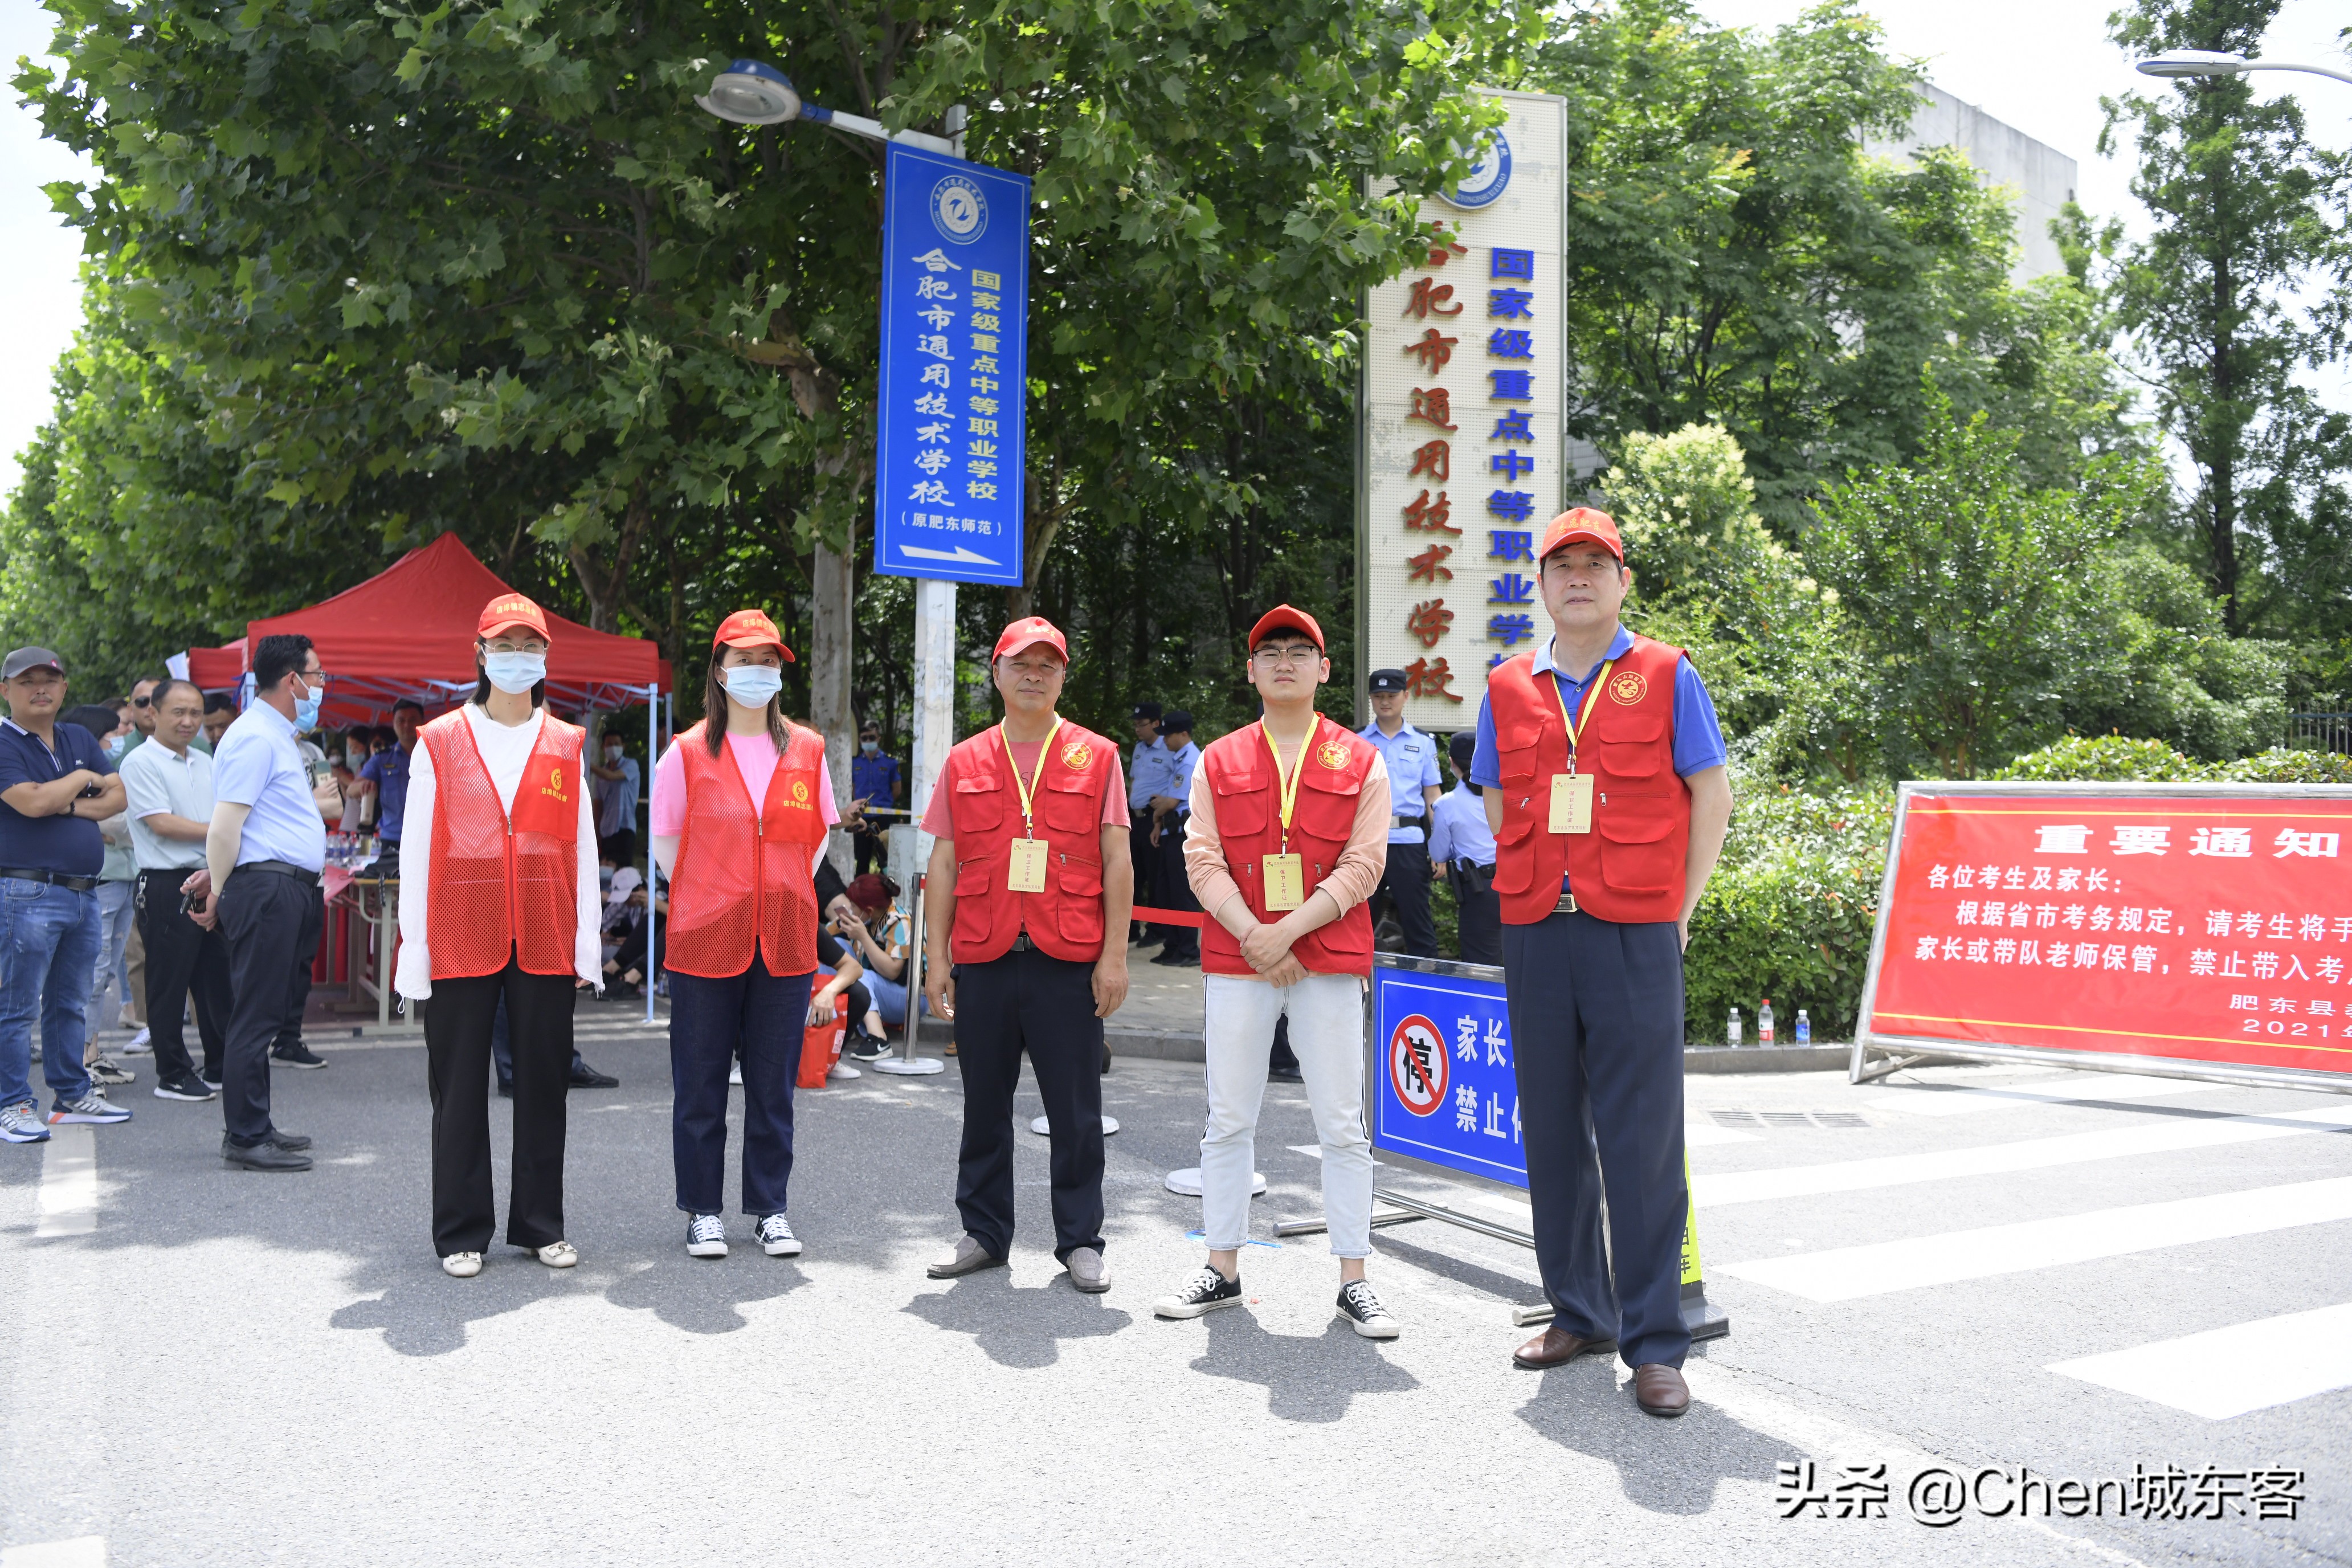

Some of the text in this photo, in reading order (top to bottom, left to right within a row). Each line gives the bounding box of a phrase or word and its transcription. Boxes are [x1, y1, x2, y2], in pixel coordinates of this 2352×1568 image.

[908, 247, 962, 508] 合肥市通用技术学校
[966, 268, 1002, 502] 国家级重点中等职业学校
[1488, 247, 1535, 670] 国家级重点中等职业学
[2034, 824, 2339, 858] 重要通知
[1914, 936, 2352, 986] 家长或带队老师保管，禁止带入考
[1456, 1014, 1516, 1069] 家长
